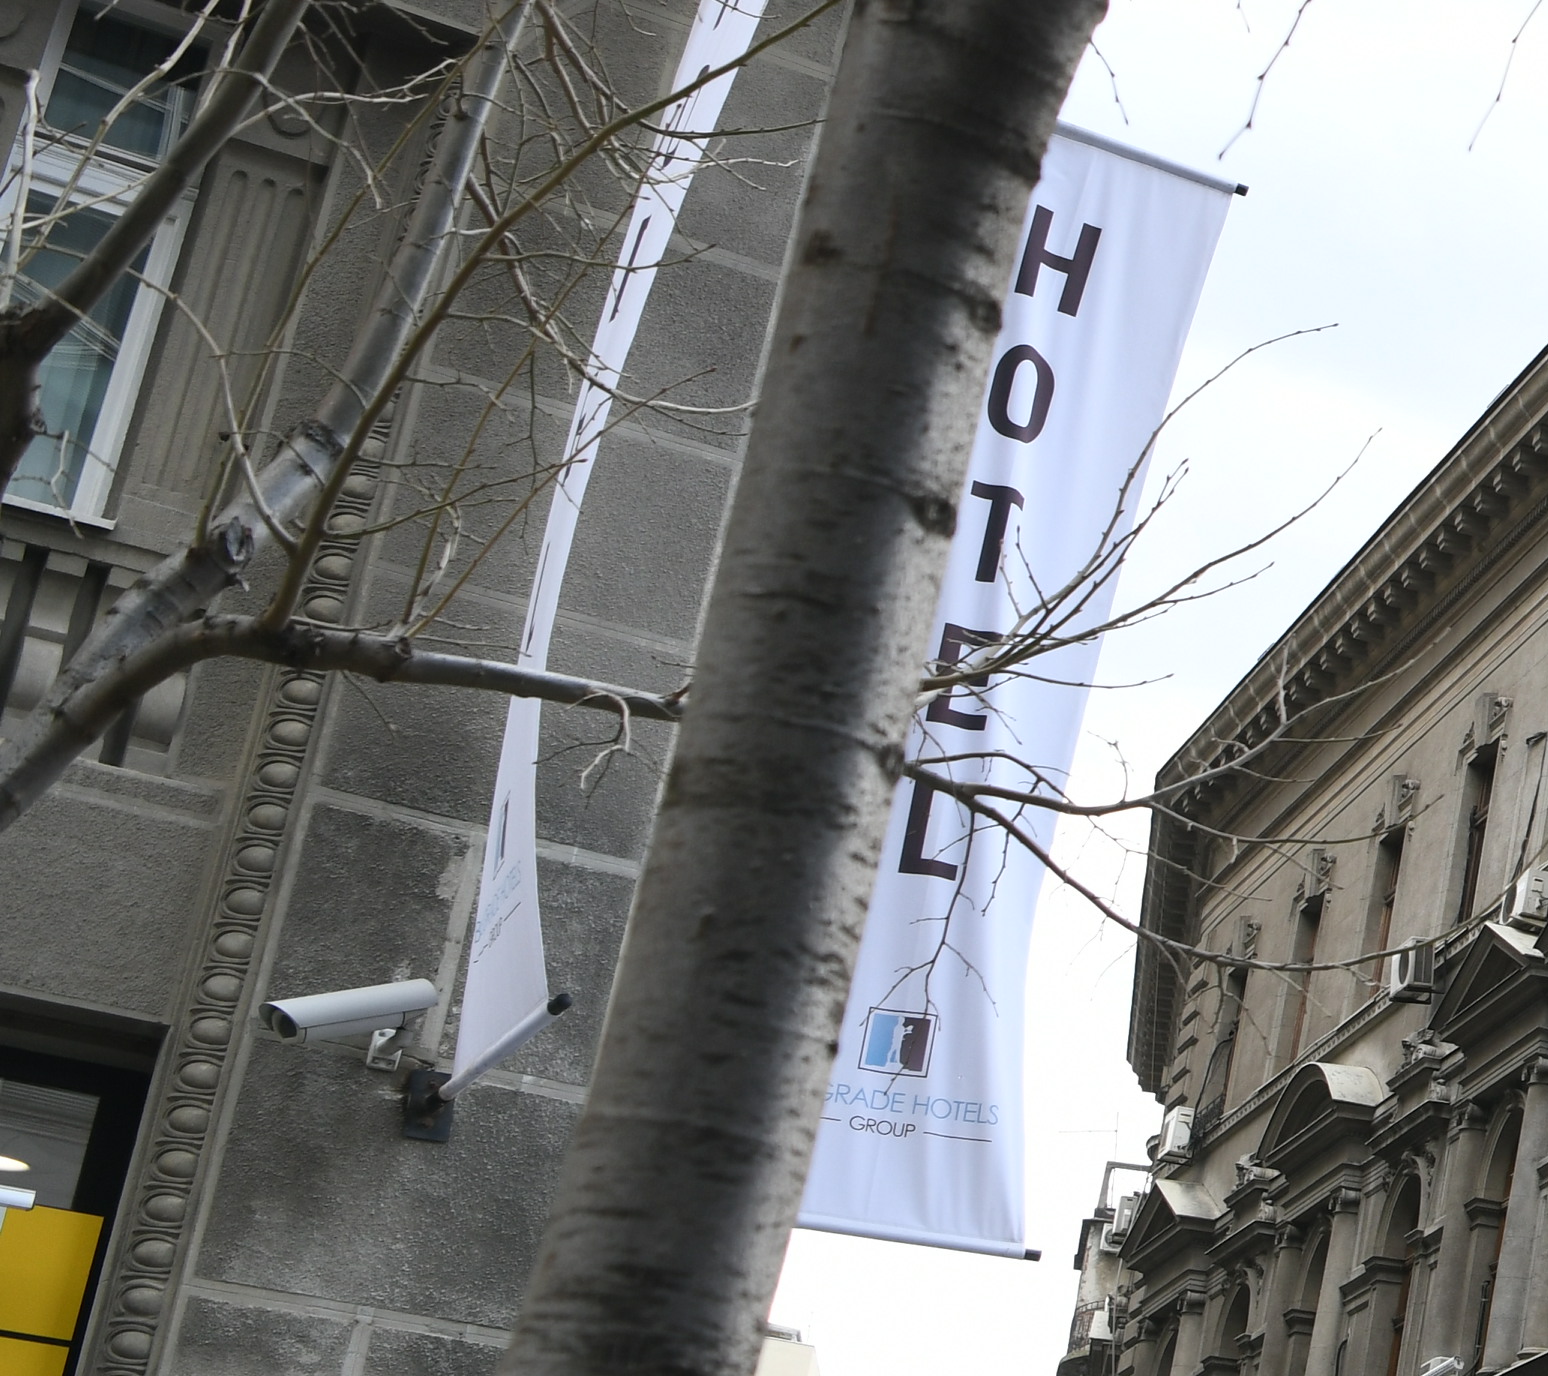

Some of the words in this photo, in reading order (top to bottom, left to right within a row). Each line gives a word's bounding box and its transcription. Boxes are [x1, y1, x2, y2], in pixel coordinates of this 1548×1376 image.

[898, 204, 1102, 881] HOTEL
[911, 1094, 999, 1125] HOTELS
[849, 1115, 916, 1138] GROUP
